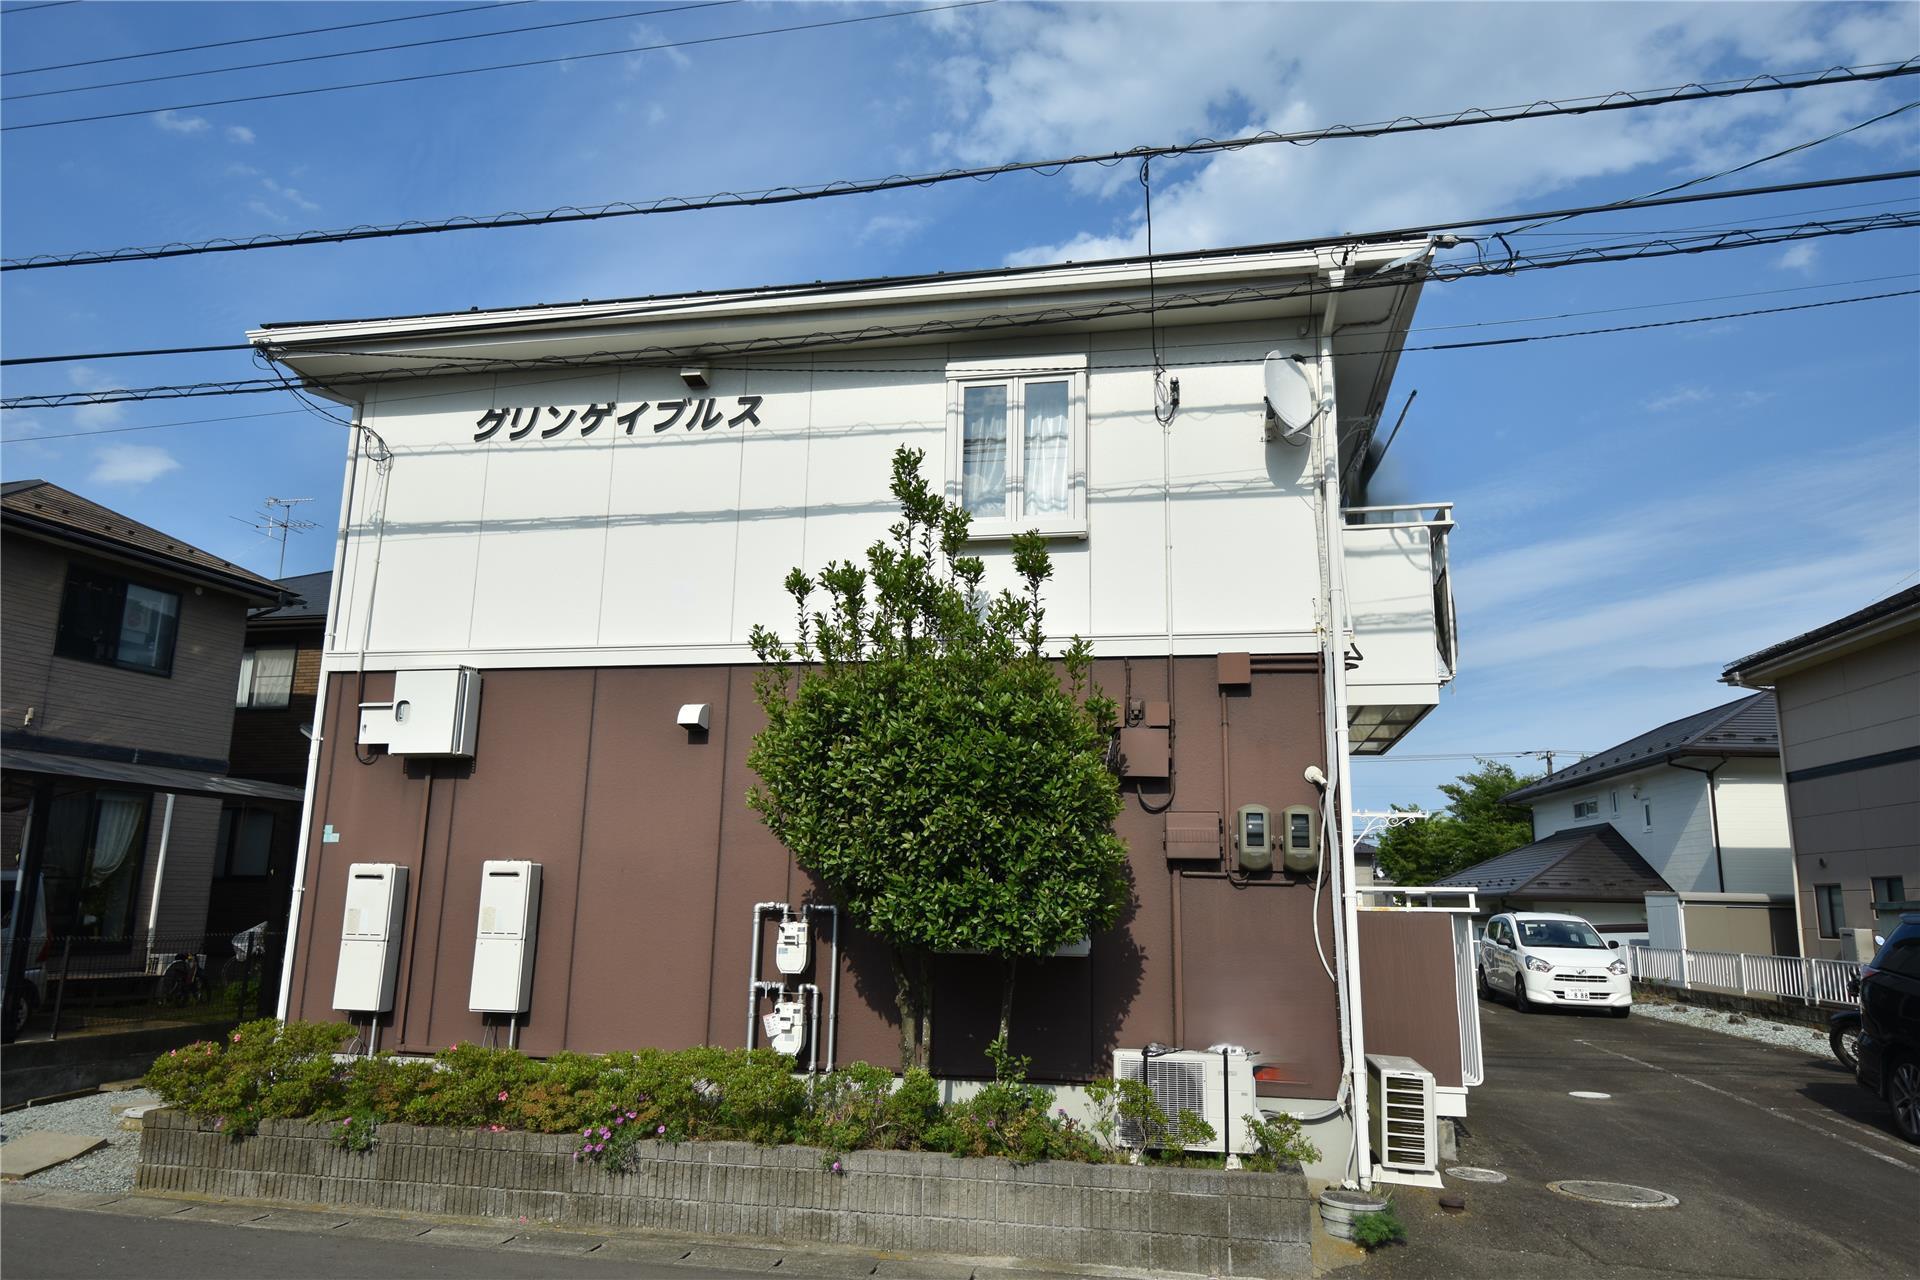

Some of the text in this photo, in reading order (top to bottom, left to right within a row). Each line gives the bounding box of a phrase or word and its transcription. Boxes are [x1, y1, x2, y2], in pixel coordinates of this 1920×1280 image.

[474, 396, 763, 442] グリンゲイブルス
